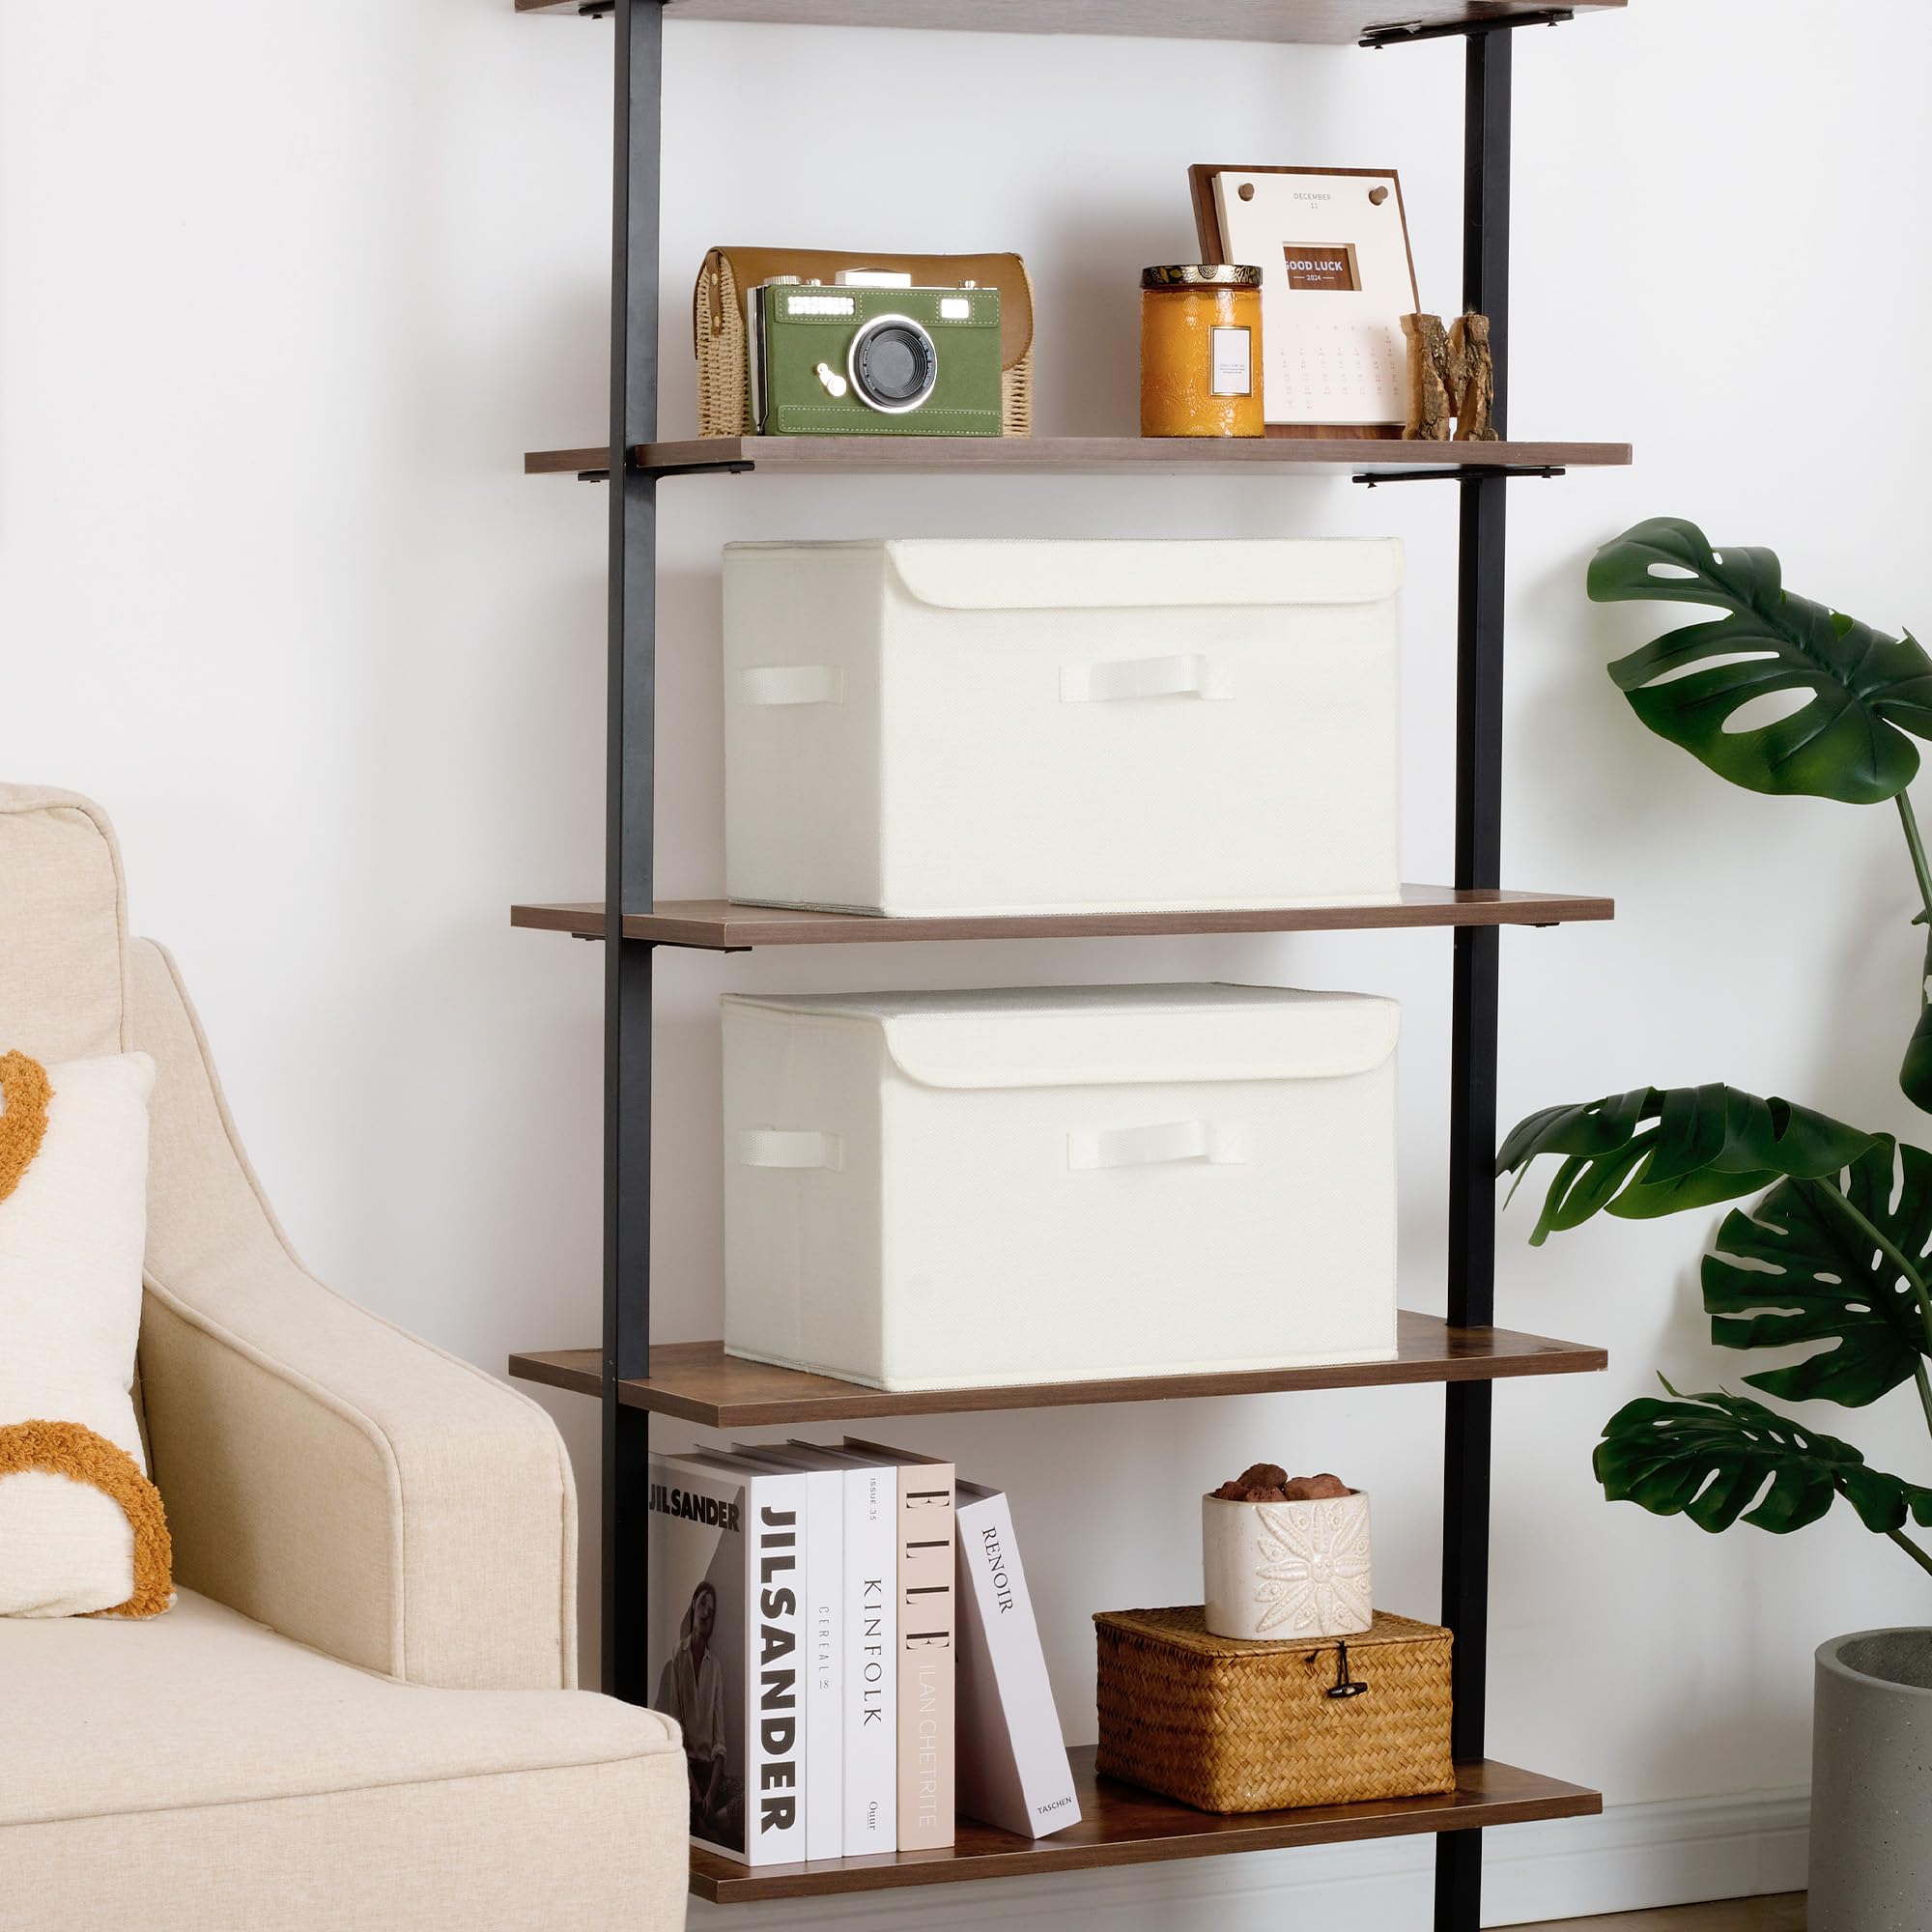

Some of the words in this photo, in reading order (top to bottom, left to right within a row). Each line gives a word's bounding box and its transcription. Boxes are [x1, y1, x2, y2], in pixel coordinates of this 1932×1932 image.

[1293, 192, 1331, 201] DECEMBER
[1314, 261, 1343, 271] LUCK
[869, 1509, 877, 1521] 35
[905, 1490, 951, 1651] ELLE
[981, 1525, 1014, 1615] RENOIR
[818, 1605, 830, 1672] CEREAL
[863, 1577, 883, 1726] KINFOLK
[1037, 1796, 1072, 1814] TASCHEN
